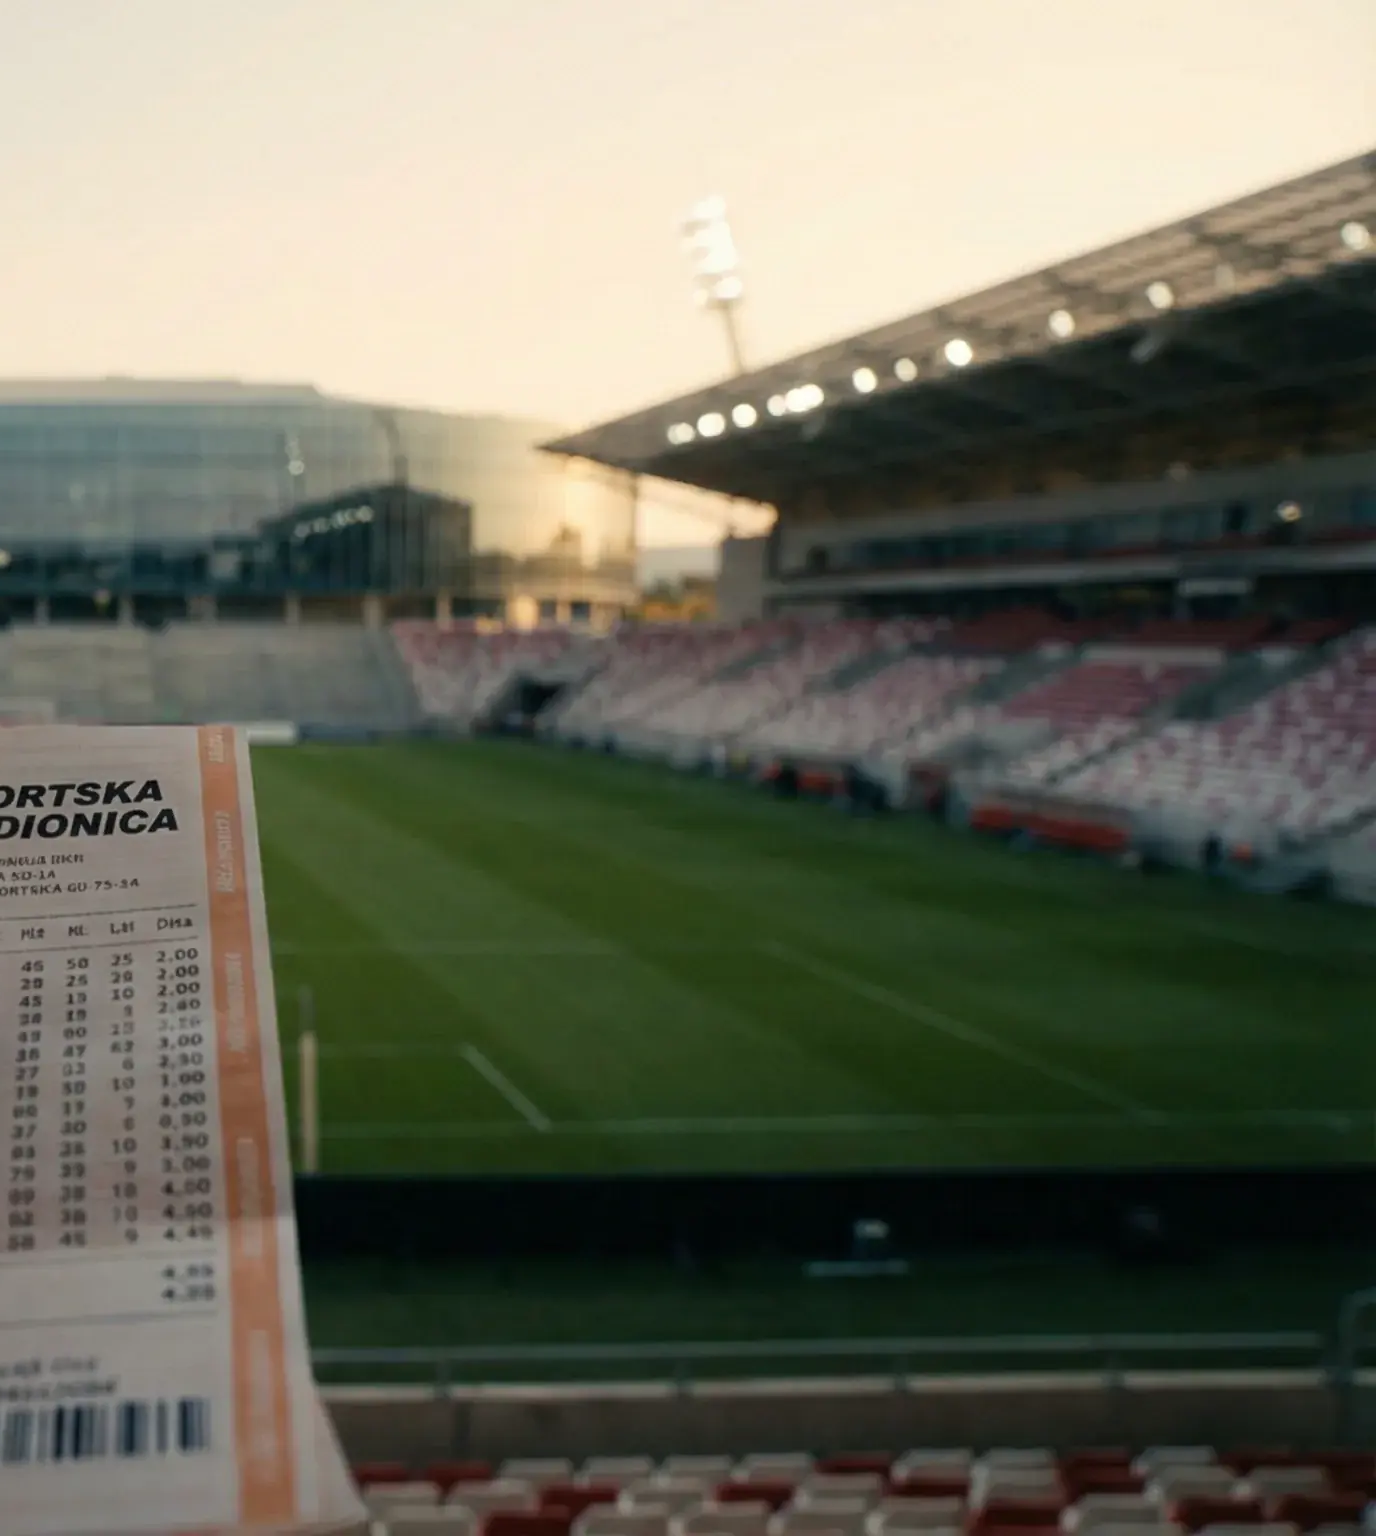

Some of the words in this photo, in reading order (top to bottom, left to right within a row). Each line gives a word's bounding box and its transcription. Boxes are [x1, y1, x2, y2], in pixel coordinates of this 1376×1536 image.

[156, 948, 199, 963] 2.00
[156, 964, 199, 980] 2.00
[157, 981, 200, 996] 2.00
